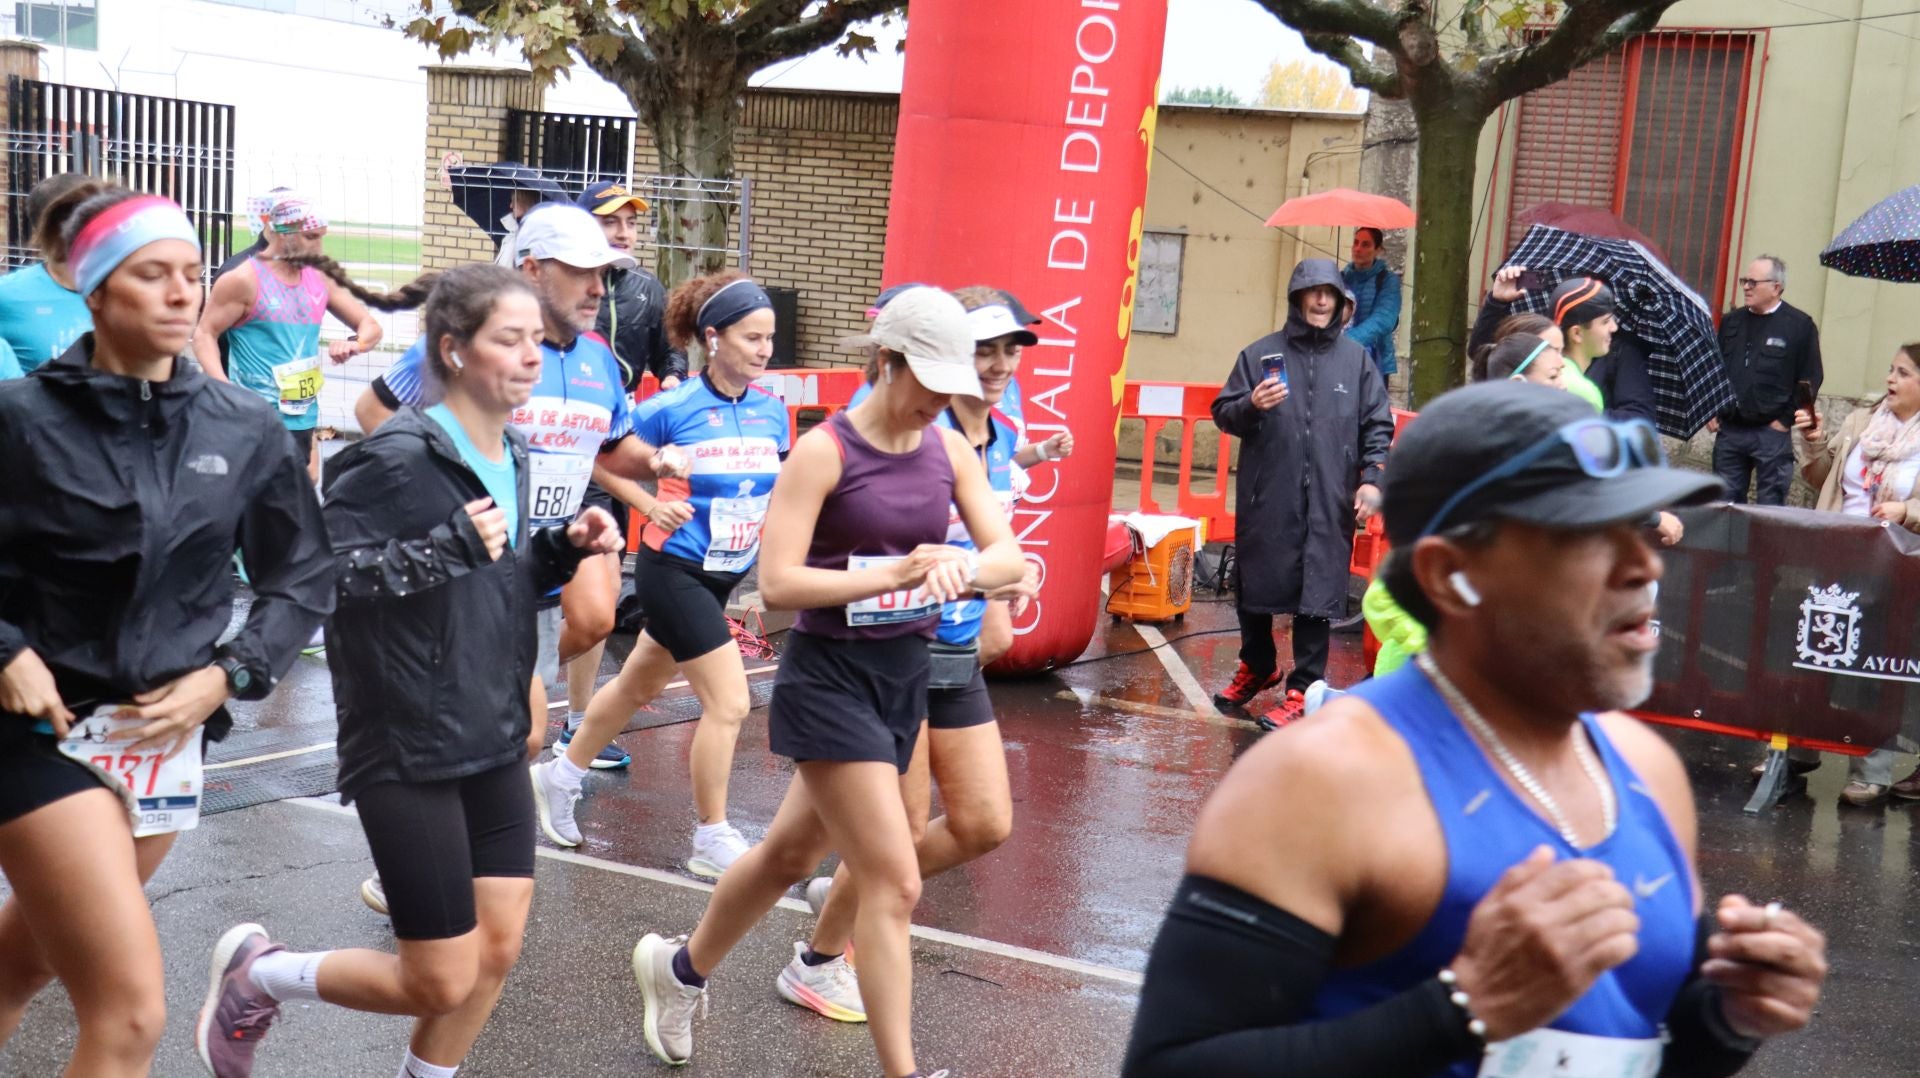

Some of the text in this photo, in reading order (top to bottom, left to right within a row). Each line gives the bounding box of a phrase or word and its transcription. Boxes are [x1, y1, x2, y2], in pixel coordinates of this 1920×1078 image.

[1060, 0, 1120, 173] DEPO
[1046, 198, 1095, 271] DE
[299, 377, 315, 399] 63
[540, 409, 559, 426] DE
[529, 430, 580, 448] LEÓN
[533, 485, 572, 517] 681
[1861, 655, 1920, 675] AYUN
